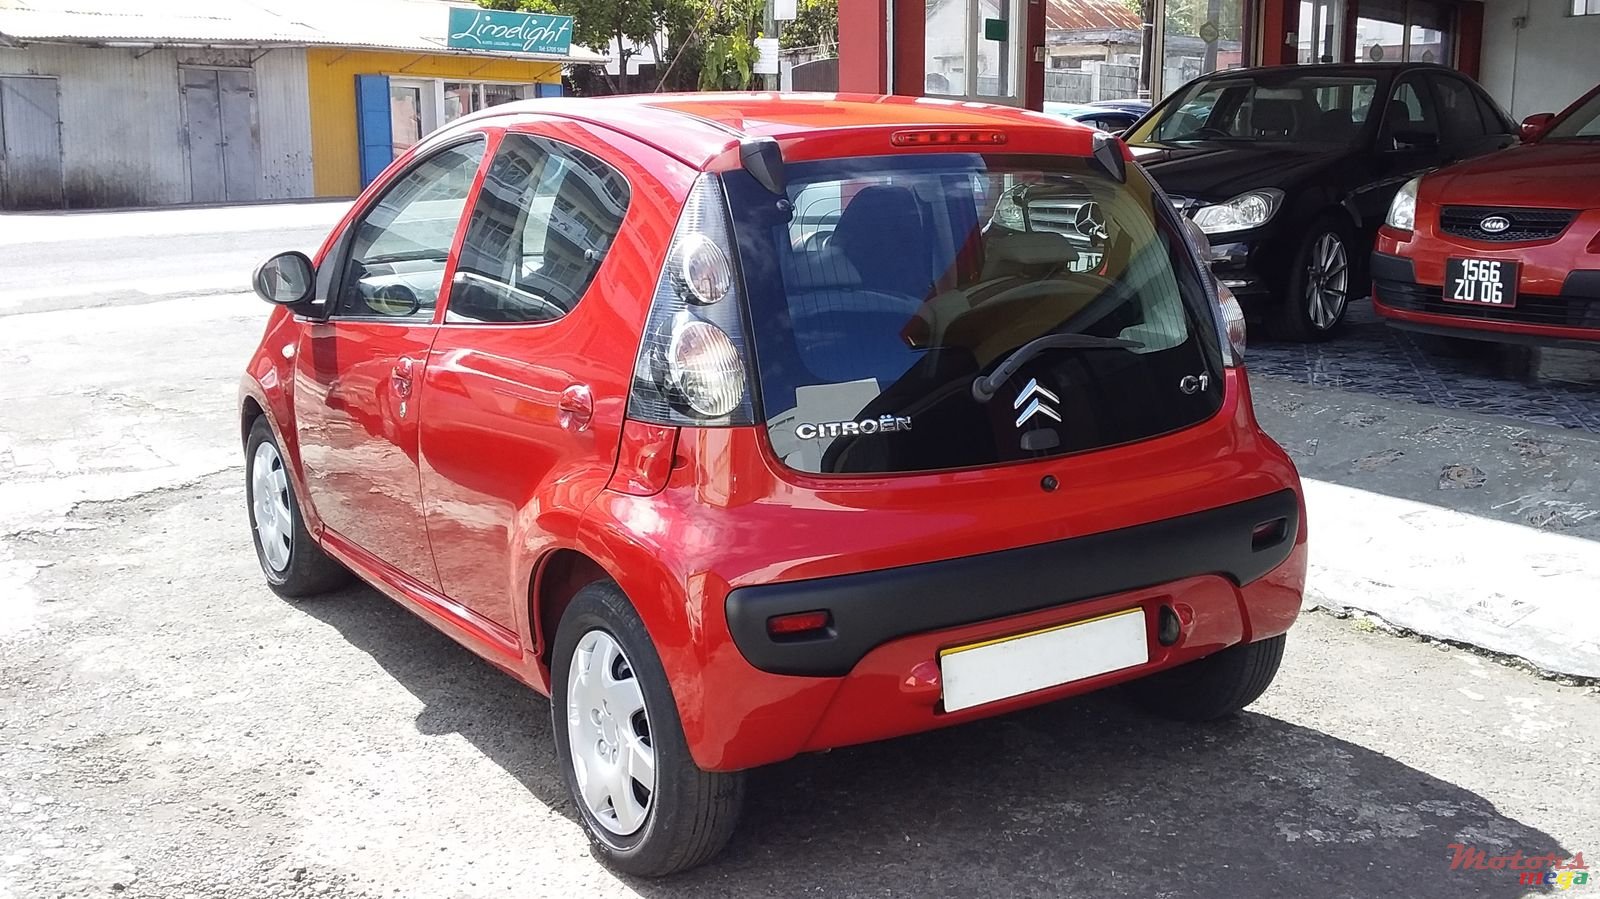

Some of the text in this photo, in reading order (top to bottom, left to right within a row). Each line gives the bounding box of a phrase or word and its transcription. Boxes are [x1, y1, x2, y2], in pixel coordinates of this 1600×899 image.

[451, 12, 570, 51] Limelight
[1484, 220, 1505, 229] KIA
[1461, 259, 1501, 282] 1566
[1454, 279, 1503, 304] ZU 06
[1180, 375, 1208, 395] C1
[795, 414, 913, 439] CITROËN
